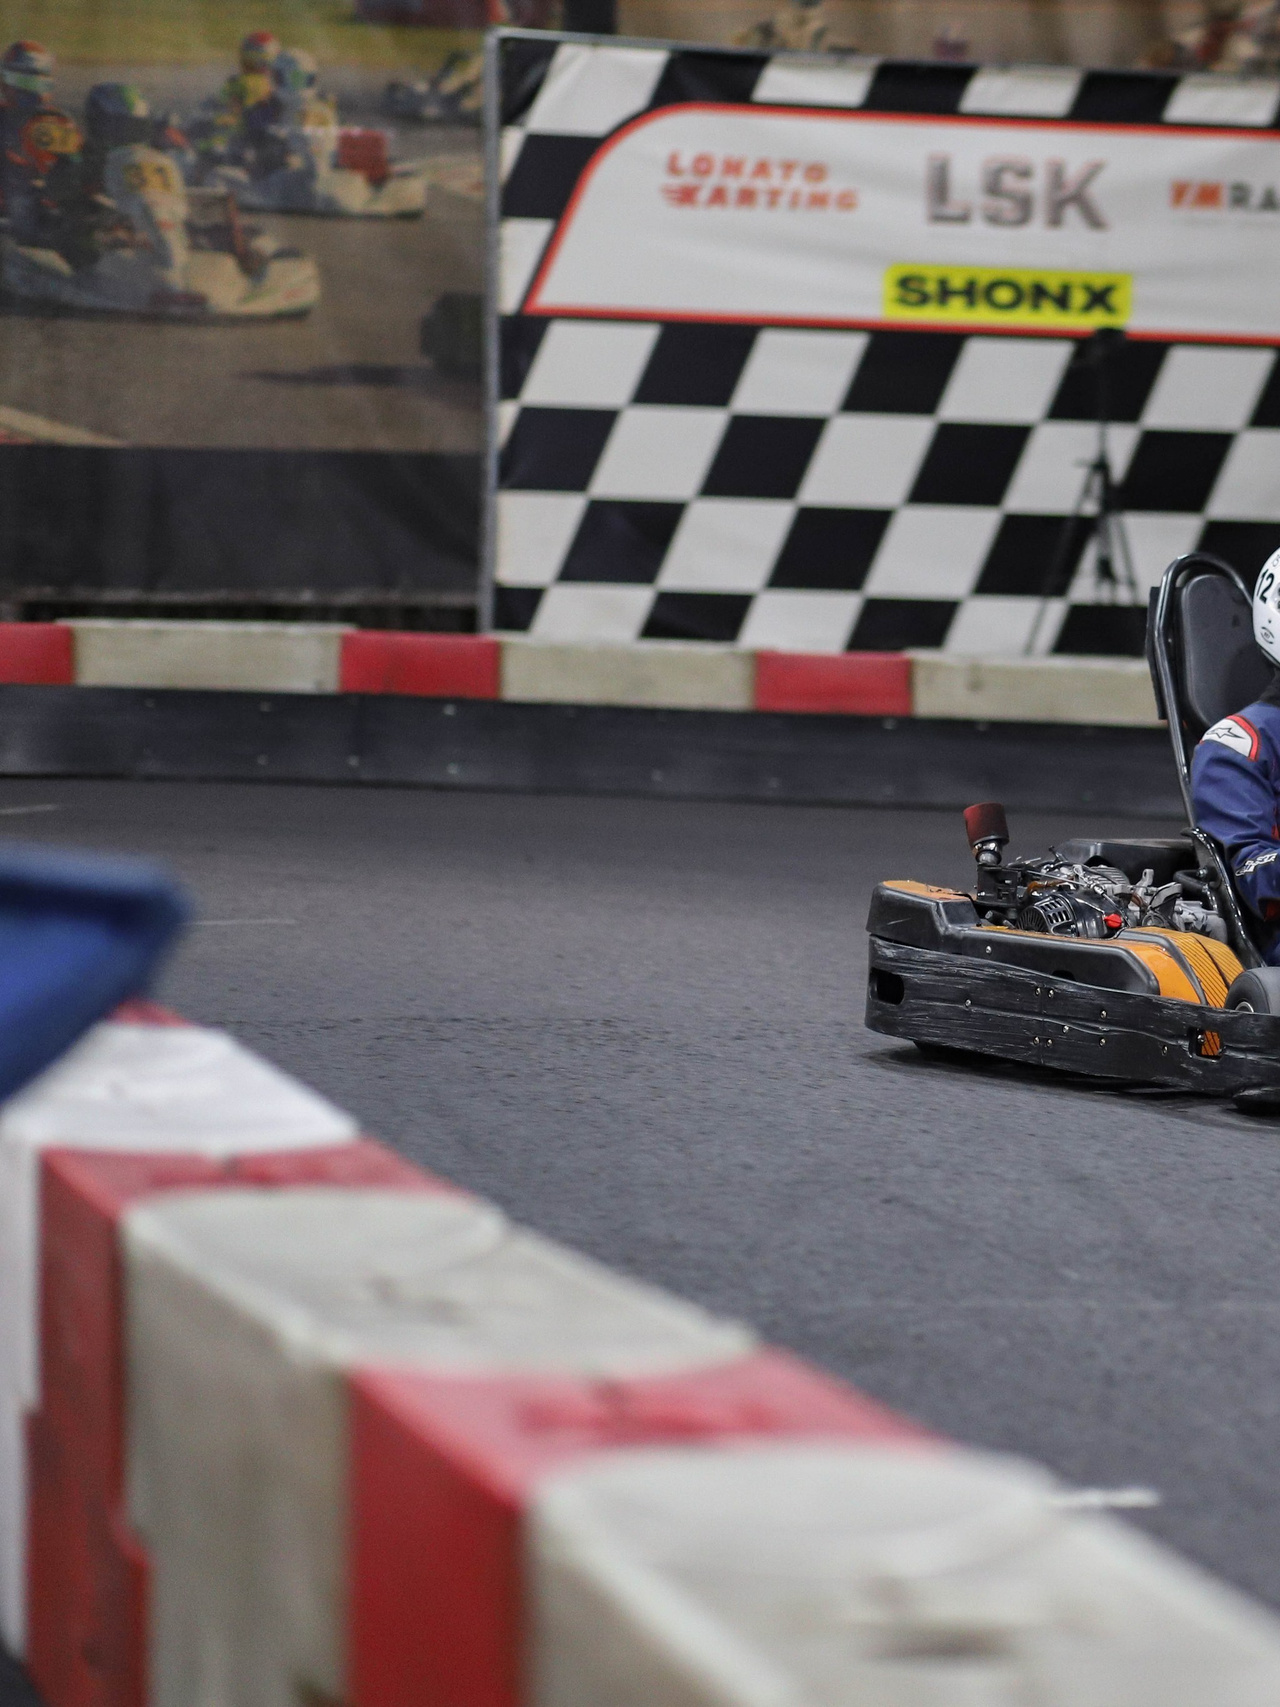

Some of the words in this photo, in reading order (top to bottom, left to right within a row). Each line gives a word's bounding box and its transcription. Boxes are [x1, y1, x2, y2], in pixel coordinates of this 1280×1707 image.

[661, 184, 858, 213] KARTING
[925, 152, 1108, 232] LSK
[895, 274, 1118, 315] SHONX
[1256, 569, 1275, 605] 12
